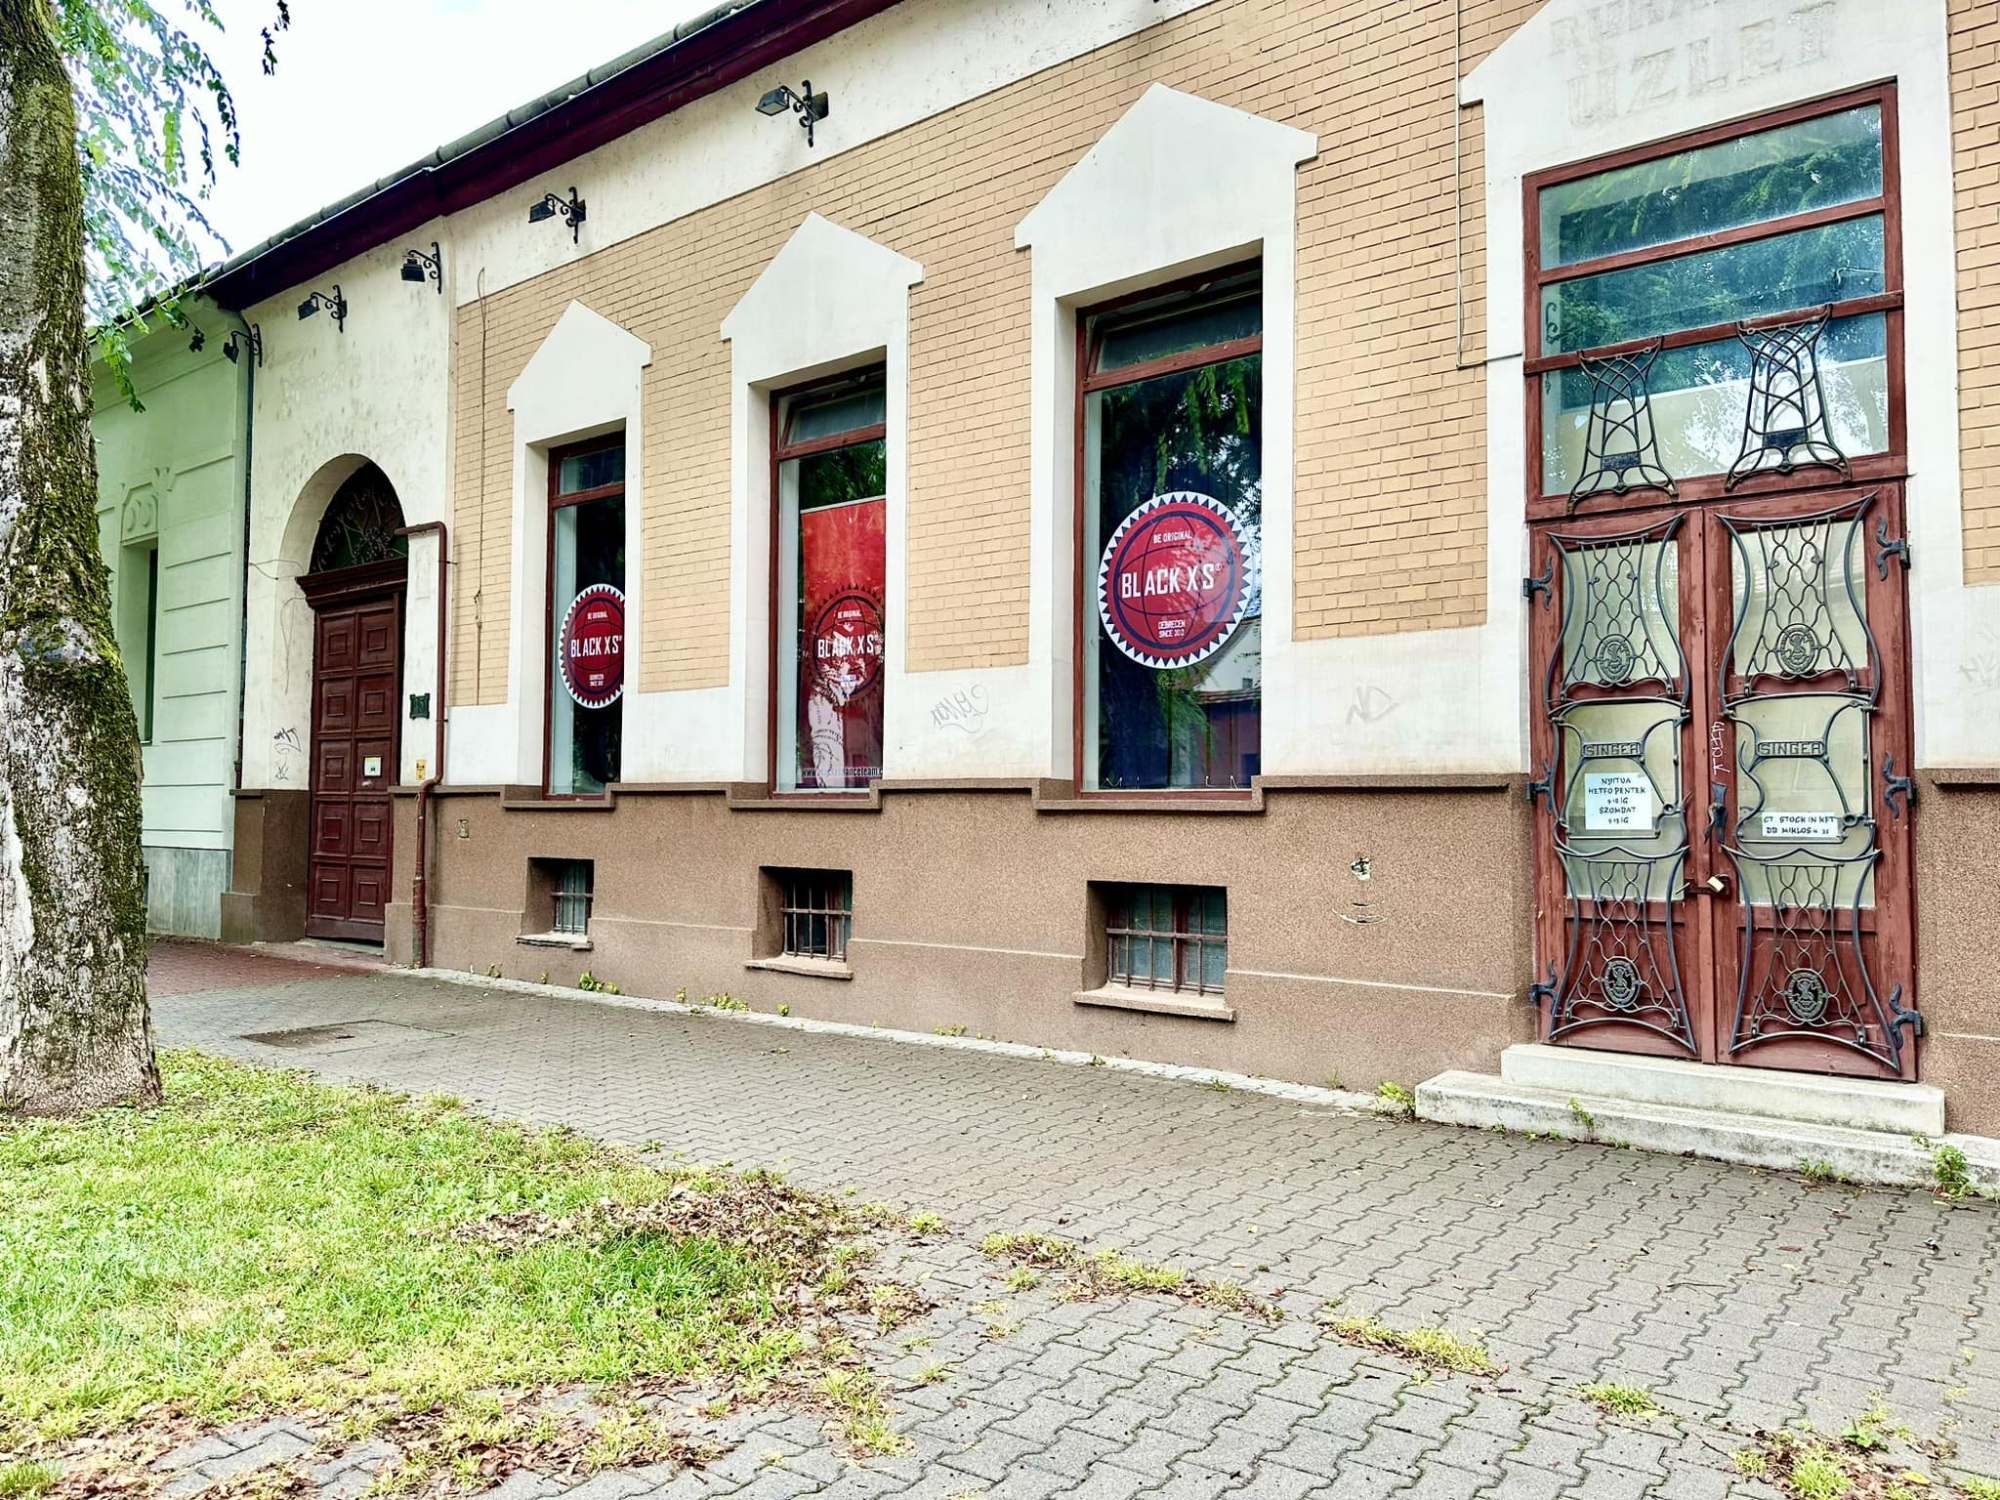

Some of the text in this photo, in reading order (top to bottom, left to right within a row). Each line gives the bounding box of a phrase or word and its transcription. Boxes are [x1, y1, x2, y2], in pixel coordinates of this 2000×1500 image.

[1153, 530, 1193, 544] BE ORIGINAL
[1121, 567, 1181, 599] BLACK
[570, 637, 602, 658] BLACK
[817, 635, 854, 658] BLACK
[1585, 743, 1639, 757] SINGER
[1759, 742, 1822, 755] SINGER
